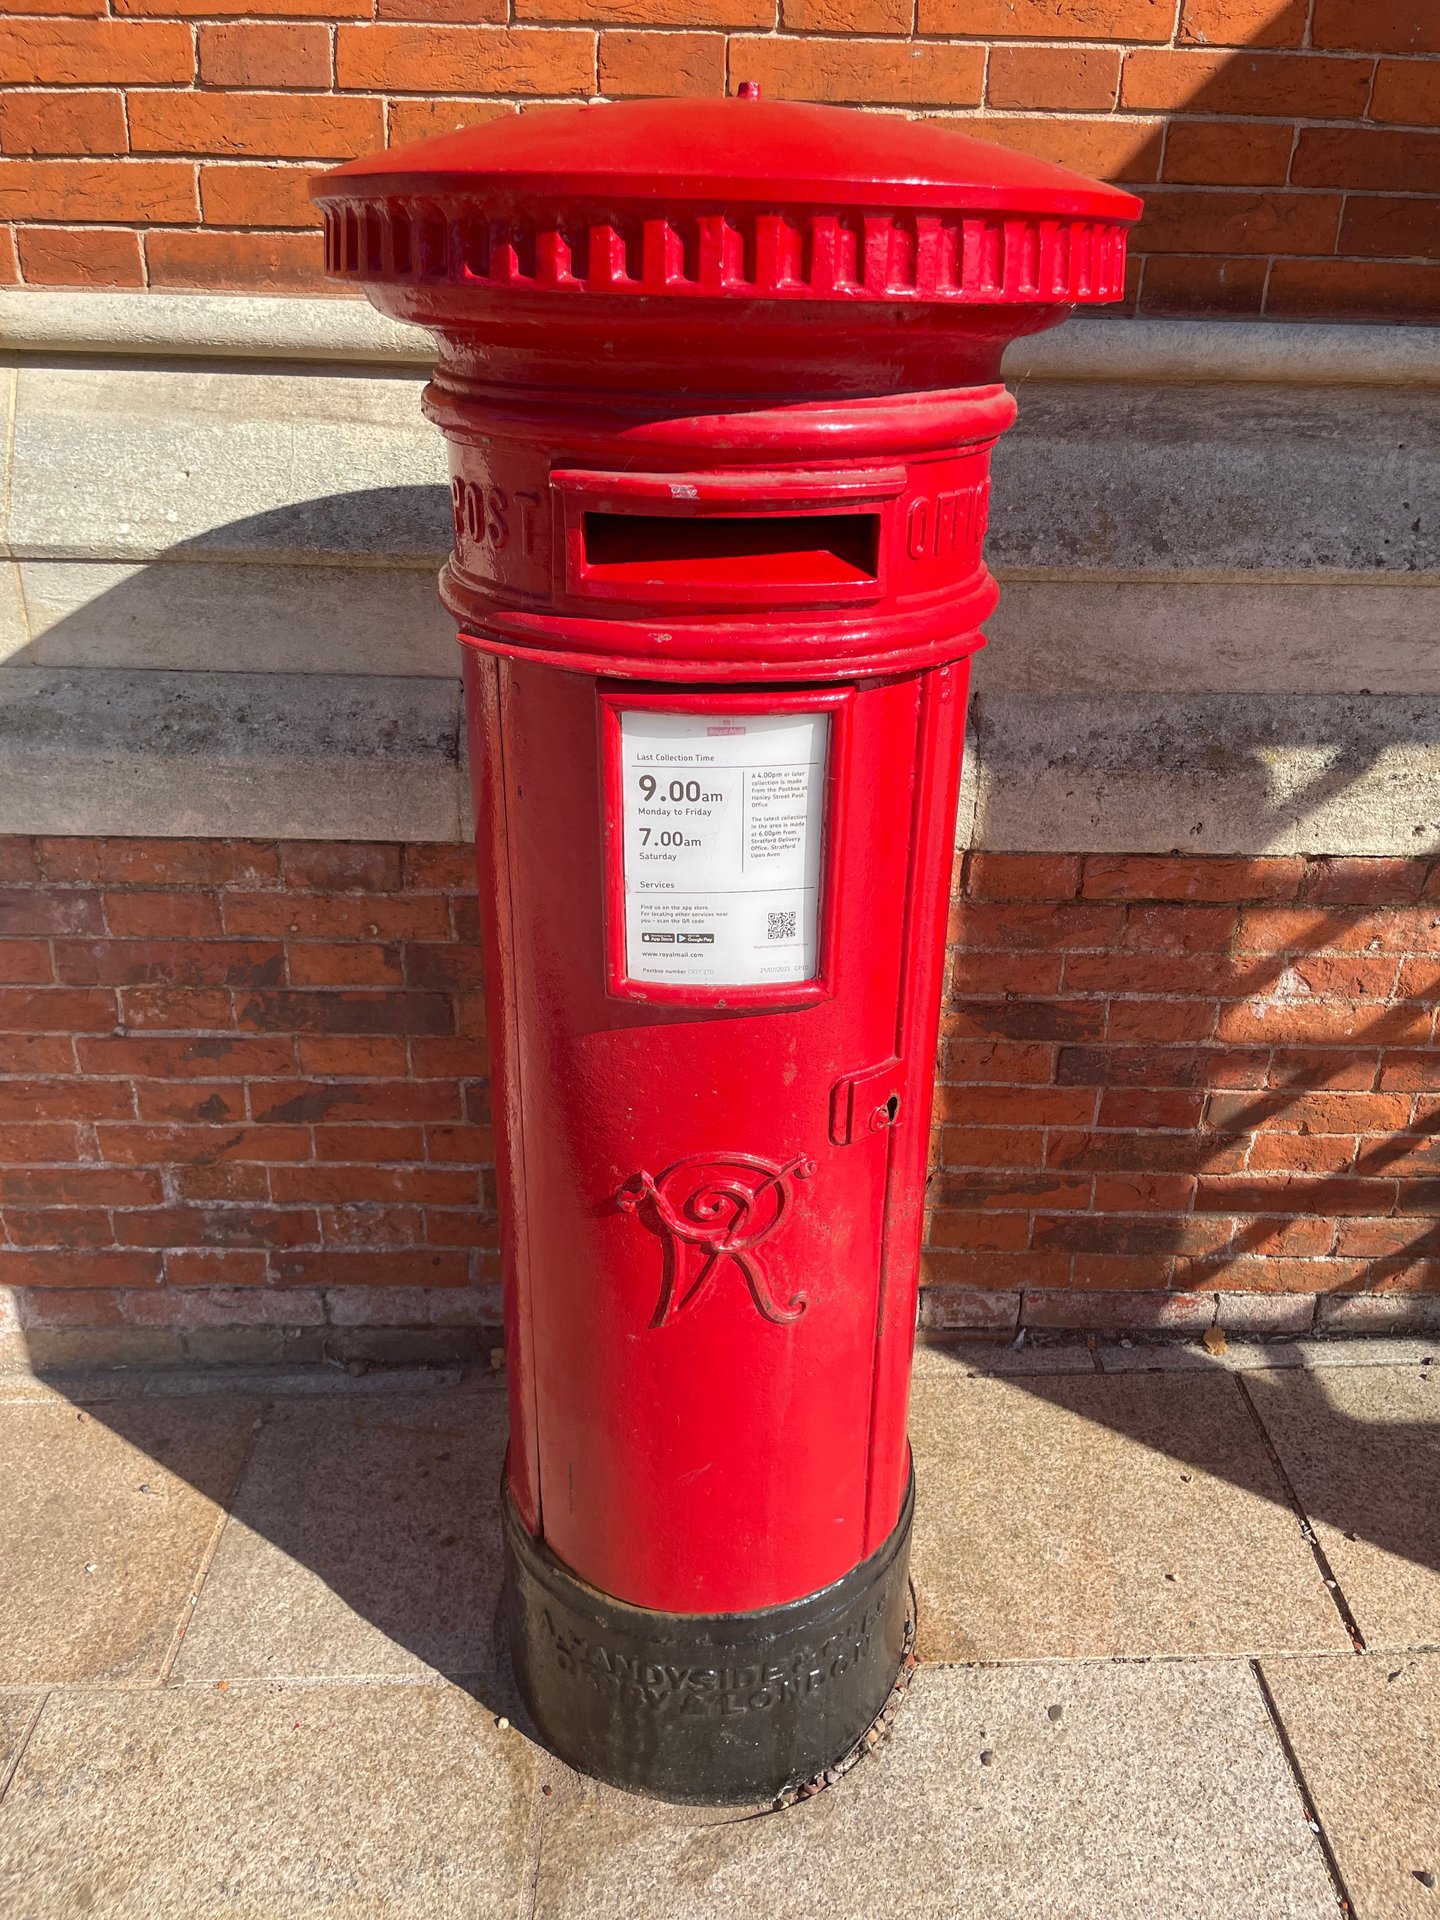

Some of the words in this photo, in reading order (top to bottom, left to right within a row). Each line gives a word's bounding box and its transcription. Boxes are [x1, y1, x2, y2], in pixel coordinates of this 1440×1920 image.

[452, 475, 541, 556] POST
[638, 774, 722, 802] 9.00am
[638, 808, 671, 816] Monday
[686, 808, 712, 816] Friday
[638, 828, 702, 846] 7.00am
[639, 852, 677, 861] Saturday
[640, 880, 675, 889] Services
